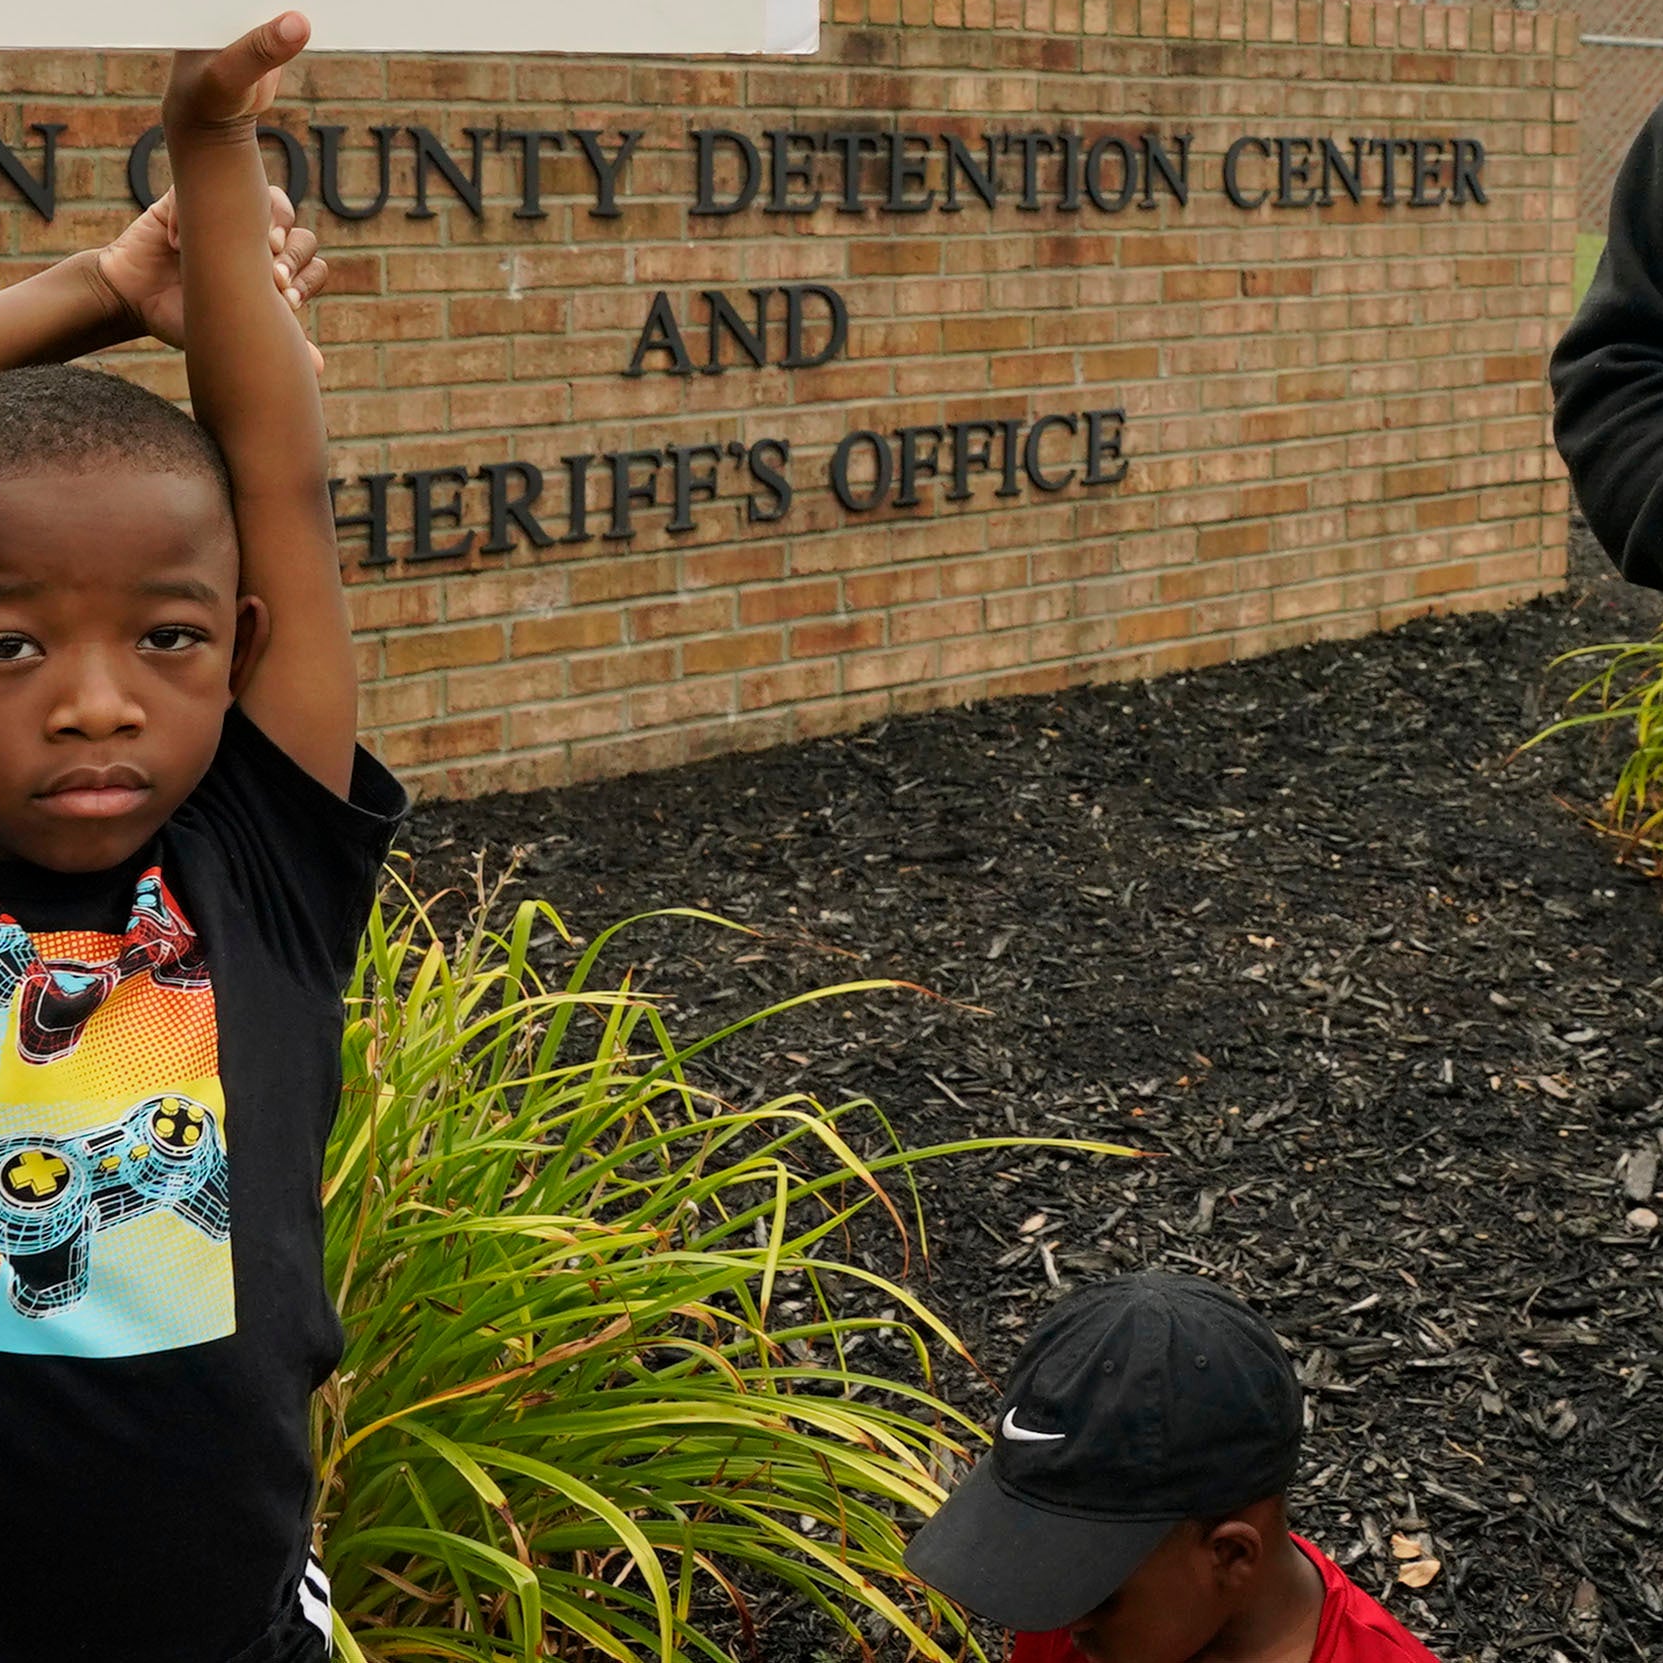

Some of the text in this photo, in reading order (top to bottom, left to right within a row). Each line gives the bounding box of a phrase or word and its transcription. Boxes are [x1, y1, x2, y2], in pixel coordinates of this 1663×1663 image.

[687, 129, 1193, 217] DETENTION
[1223, 134, 1490, 211] CENTER
[623, 283, 850, 378] AND
[328, 408, 1131, 567] HERIFF'S OFFICE
